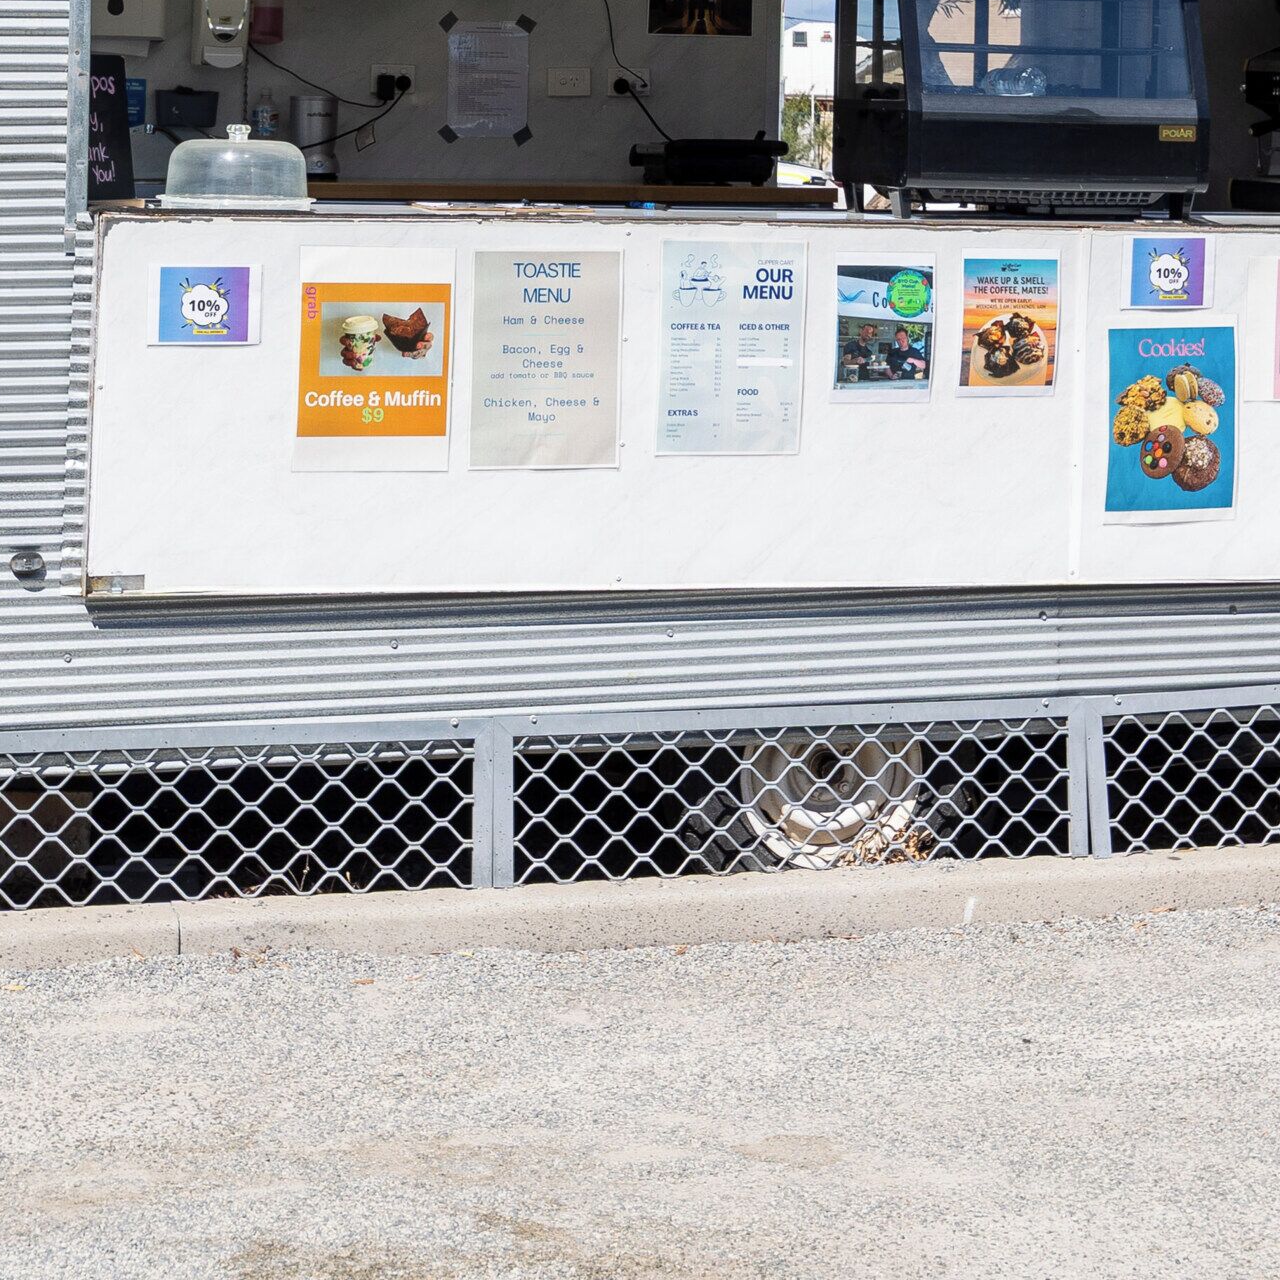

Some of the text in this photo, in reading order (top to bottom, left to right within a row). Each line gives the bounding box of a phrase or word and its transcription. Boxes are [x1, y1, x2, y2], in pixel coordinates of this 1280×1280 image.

[1162, 128, 1193, 138] POLAR
[513, 262, 581, 278] TOASTIE
[756, 268, 794, 283] OUR
[1156, 268, 1182, 278] 10%
[977, 276, 1045, 285] WAKE UP & SMELL
[523, 288, 571, 303] MENU
[743, 285, 793, 300] MENU
[974, 286, 1049, 295] THE COFFEE, MATES!
[189, 300, 220, 312] 10%
[305, 286, 319, 319] grab
[503, 316, 585, 325] Ham & Cheese
[502, 344, 584, 356] Bacon, Egg &
[1138, 338, 1205, 358] Cookies!
[522, 359, 563, 368] Cheese
[304, 390, 442, 407] Coffee & Muffin
[484, 397, 600, 408] Chicken, Cheese &
[361, 407, 384, 424] $9
[528, 412, 556, 423] Mayo
